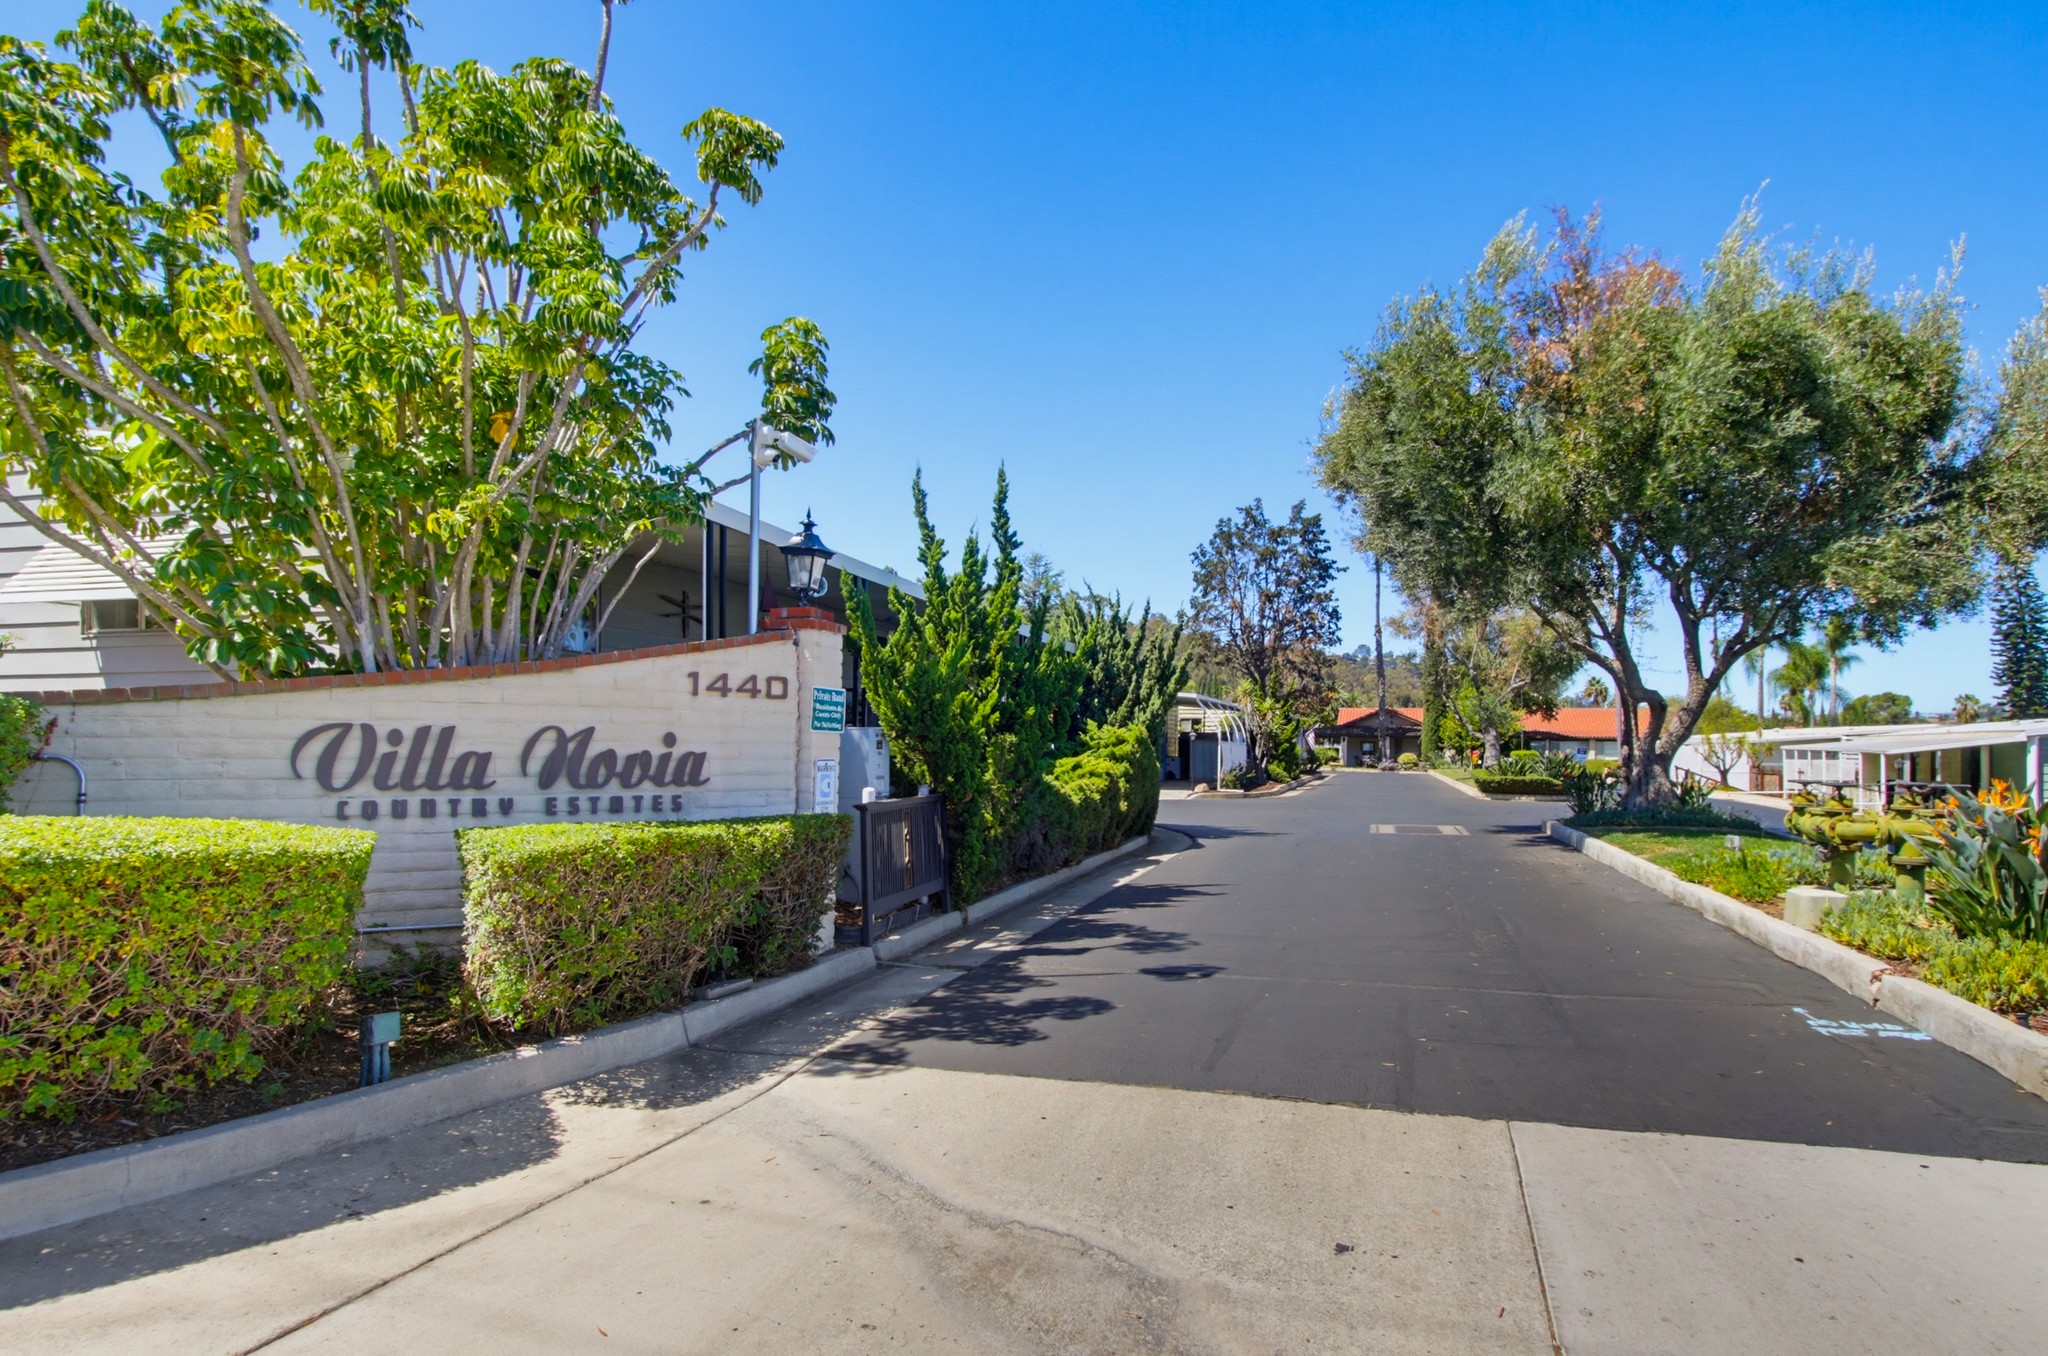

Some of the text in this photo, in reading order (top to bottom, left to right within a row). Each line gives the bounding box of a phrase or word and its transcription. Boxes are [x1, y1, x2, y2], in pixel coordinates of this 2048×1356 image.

[687, 671, 789, 700] 1440
[290, 722, 711, 793] Villa Novia
[336, 794, 683, 821] COUNTRY ESTATES
